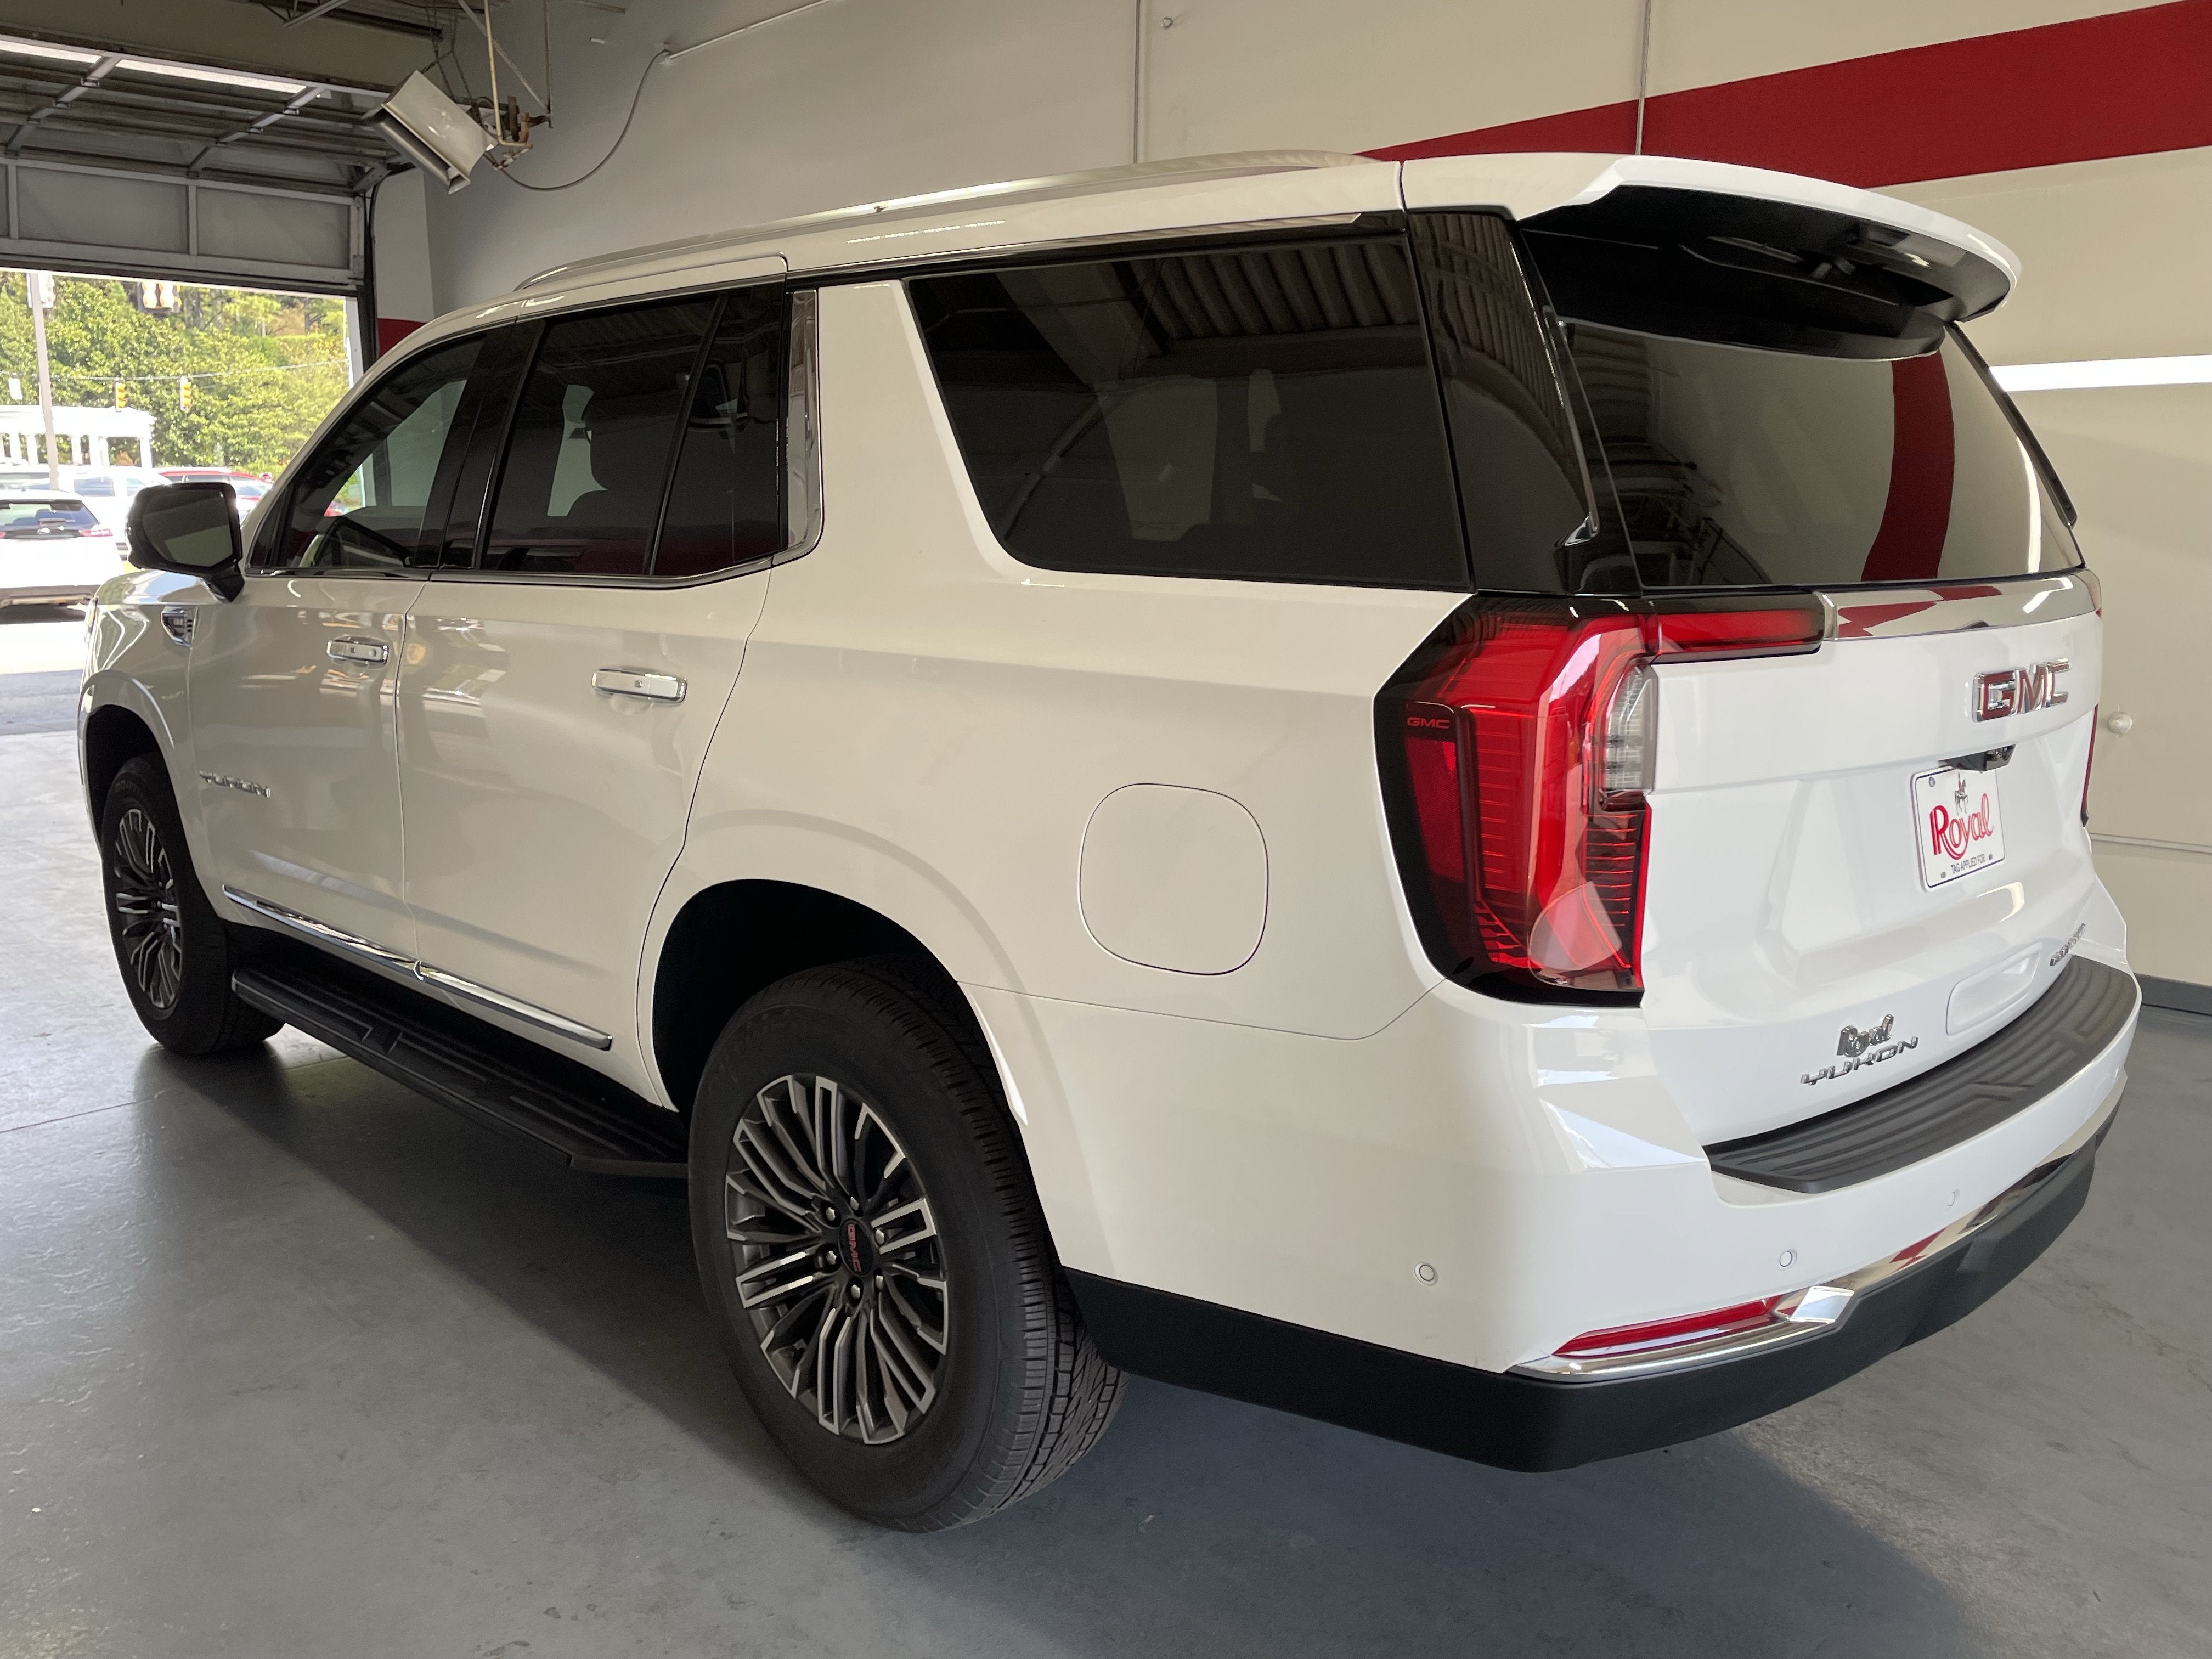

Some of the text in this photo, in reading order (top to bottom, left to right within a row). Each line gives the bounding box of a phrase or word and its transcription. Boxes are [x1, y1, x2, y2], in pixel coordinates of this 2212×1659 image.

[1972, 658, 2070, 723] GMC
[1407, 716, 1450, 729] GMC
[1929, 793, 1994, 860] Royal
[1950, 853, 1986, 874] TAG APPLIED FOR
[1801, 1036, 1919, 1085] YUKON
[847, 1223, 862, 1272] GMC
